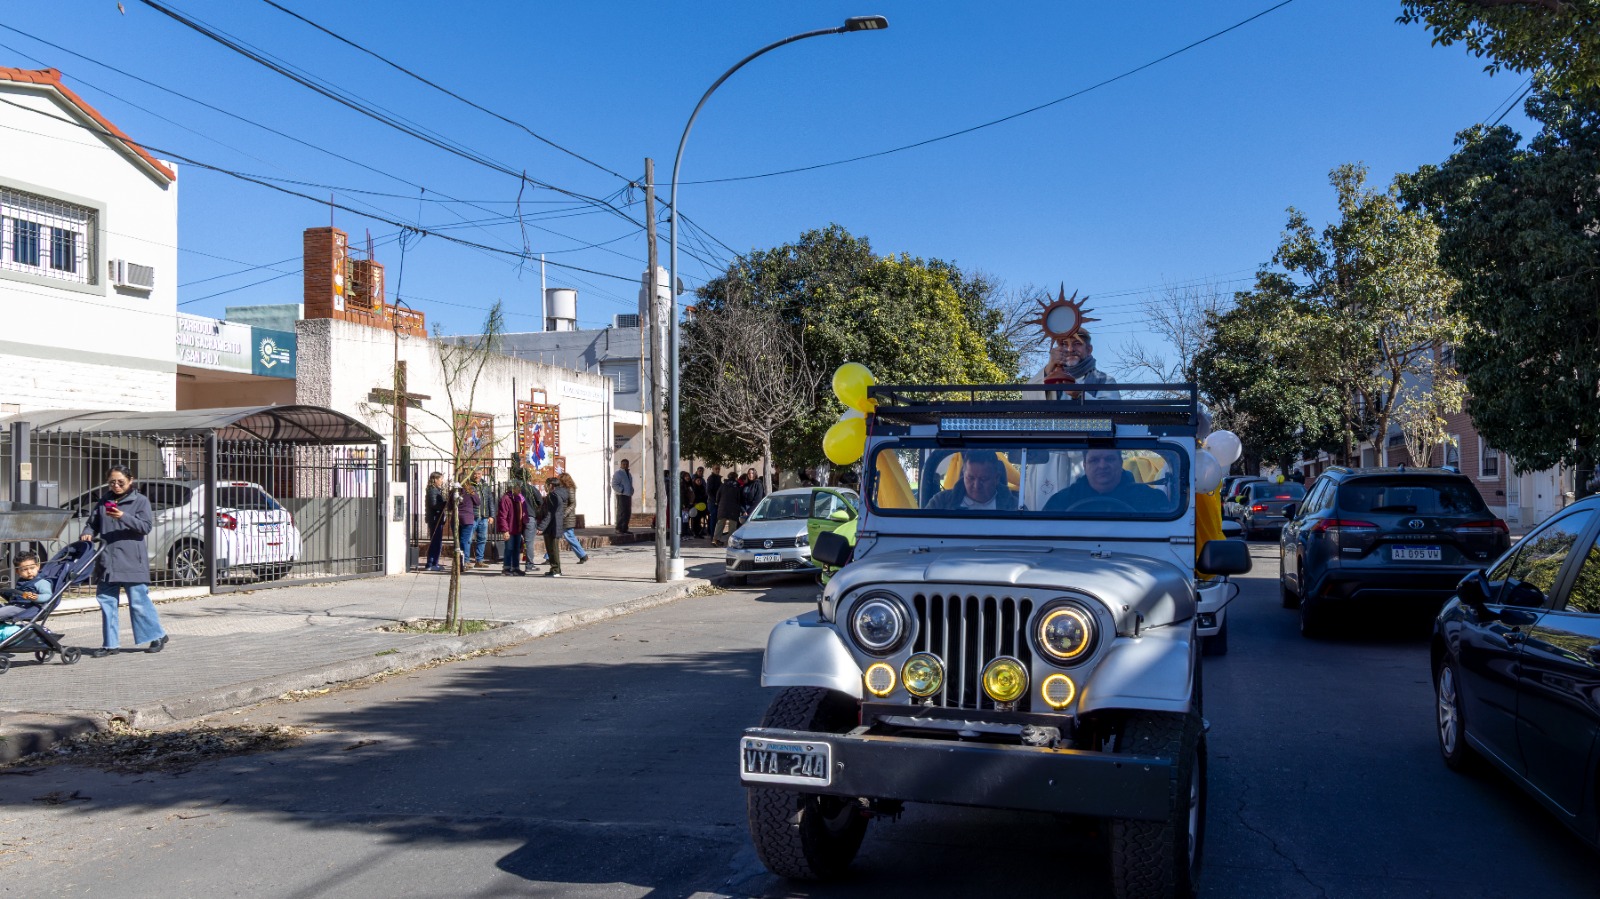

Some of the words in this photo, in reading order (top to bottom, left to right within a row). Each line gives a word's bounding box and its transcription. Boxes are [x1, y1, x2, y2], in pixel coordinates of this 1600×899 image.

[195, 336, 241, 354] SACRAMENTO
[185, 349, 201, 363] SAN
[214, 353, 221, 365] X
[767, 743, 804, 752] ARGENTINA
[747, 750, 779, 774] VYA
[790, 754, 824, 777] 244
